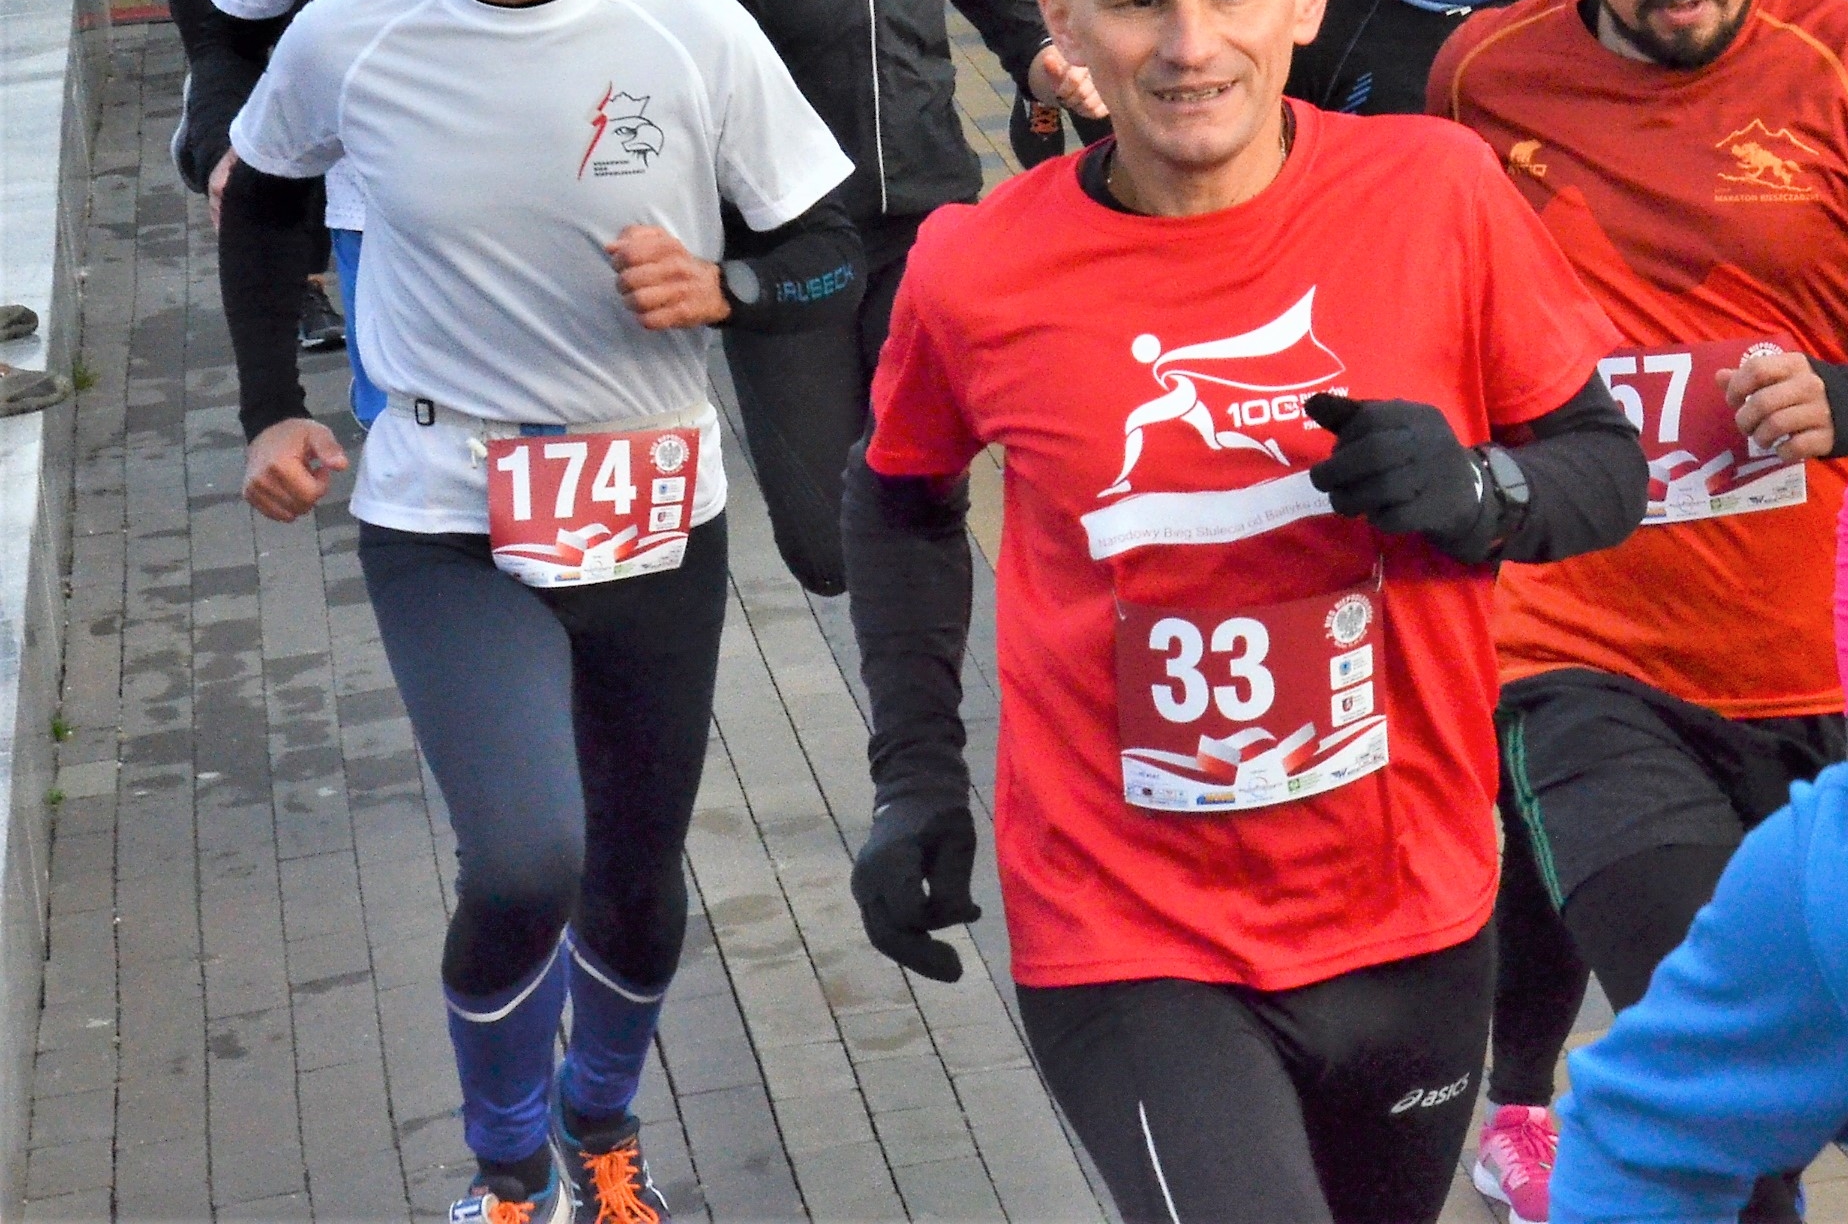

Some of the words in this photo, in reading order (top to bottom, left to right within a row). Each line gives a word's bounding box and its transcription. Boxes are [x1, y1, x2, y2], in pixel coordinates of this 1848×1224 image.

[1597, 353, 1692, 443] 57
[497, 440, 637, 521] 174
[1149, 617, 1275, 723] 33
